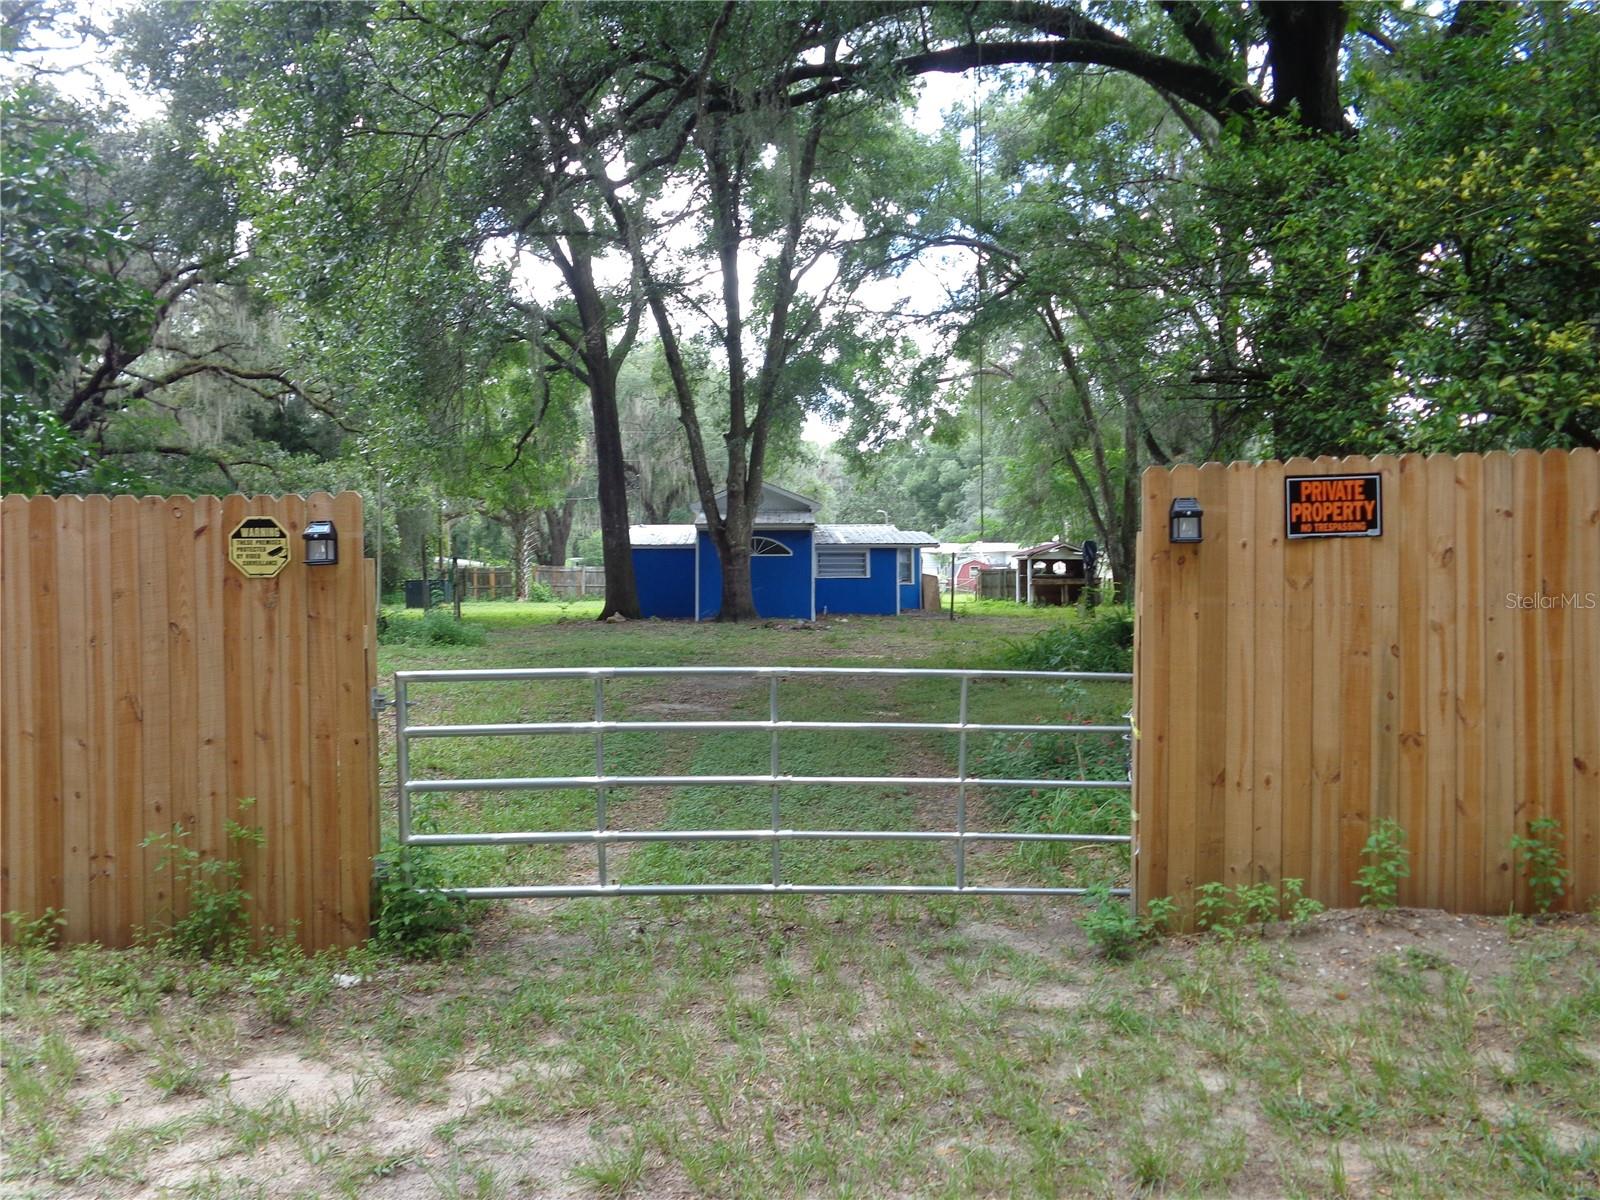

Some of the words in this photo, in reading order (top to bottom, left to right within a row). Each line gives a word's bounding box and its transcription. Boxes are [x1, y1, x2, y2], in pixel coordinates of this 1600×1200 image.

[1301, 480, 1365, 501] PRIVATE
[1291, 500, 1375, 522] PROPERTY
[240, 528, 280, 537] WARNING
